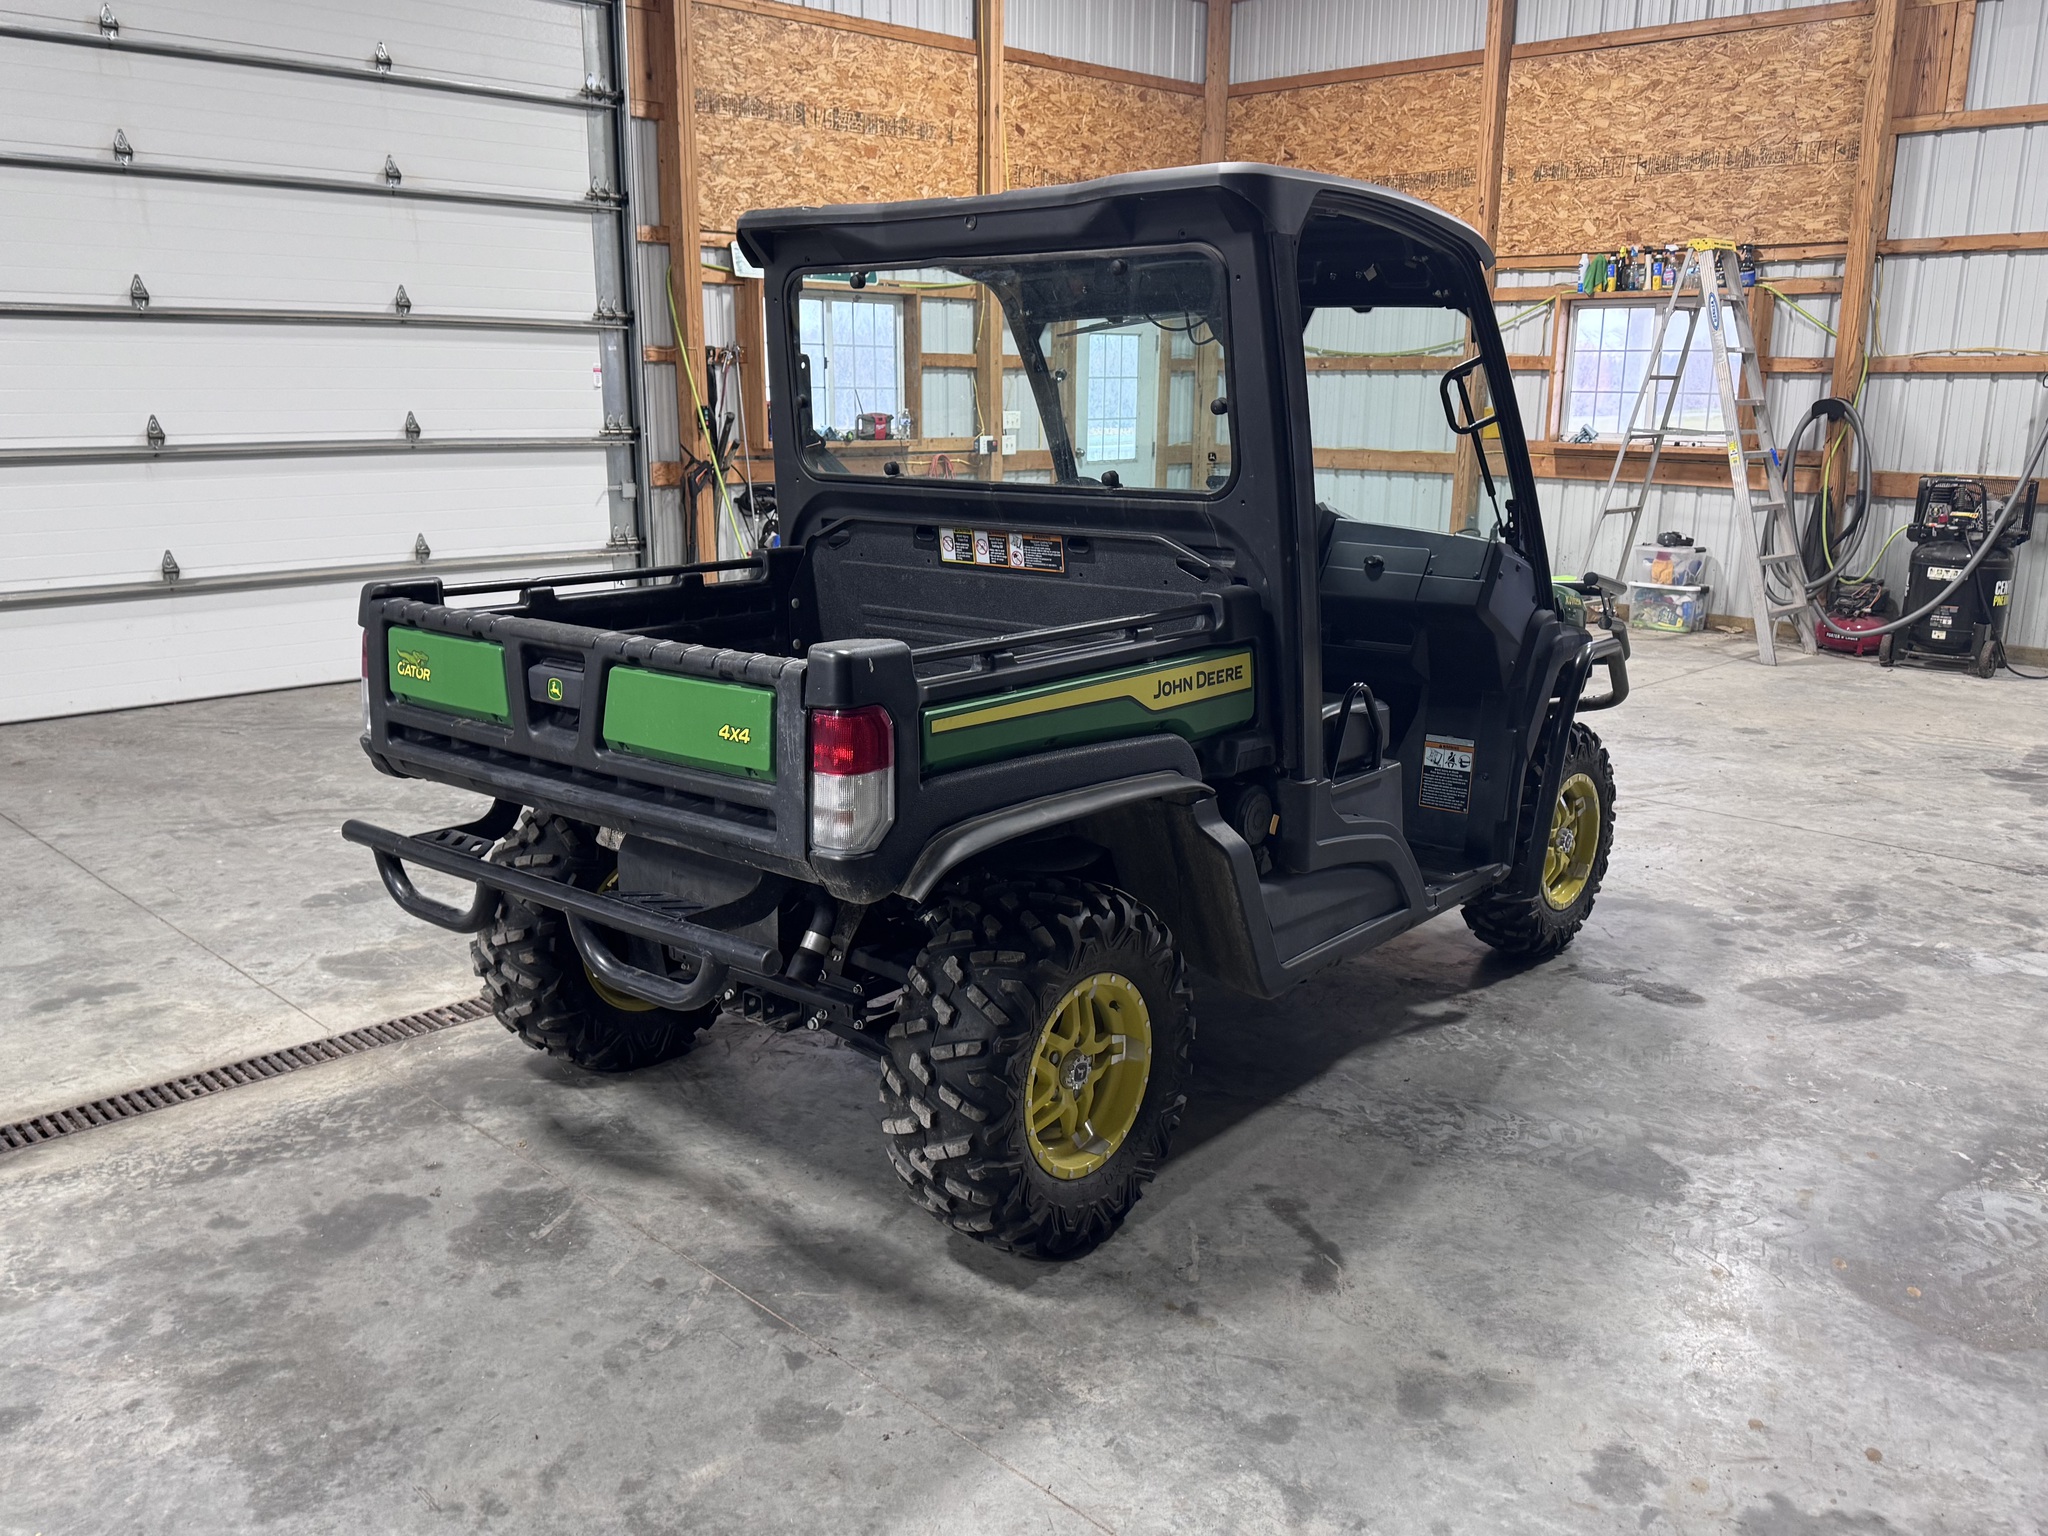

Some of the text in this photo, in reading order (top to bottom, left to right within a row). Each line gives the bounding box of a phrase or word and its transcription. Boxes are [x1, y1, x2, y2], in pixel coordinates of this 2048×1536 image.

[397, 660, 431, 682] GATOR
[1153, 665, 1243, 699] JOHN DEERE
